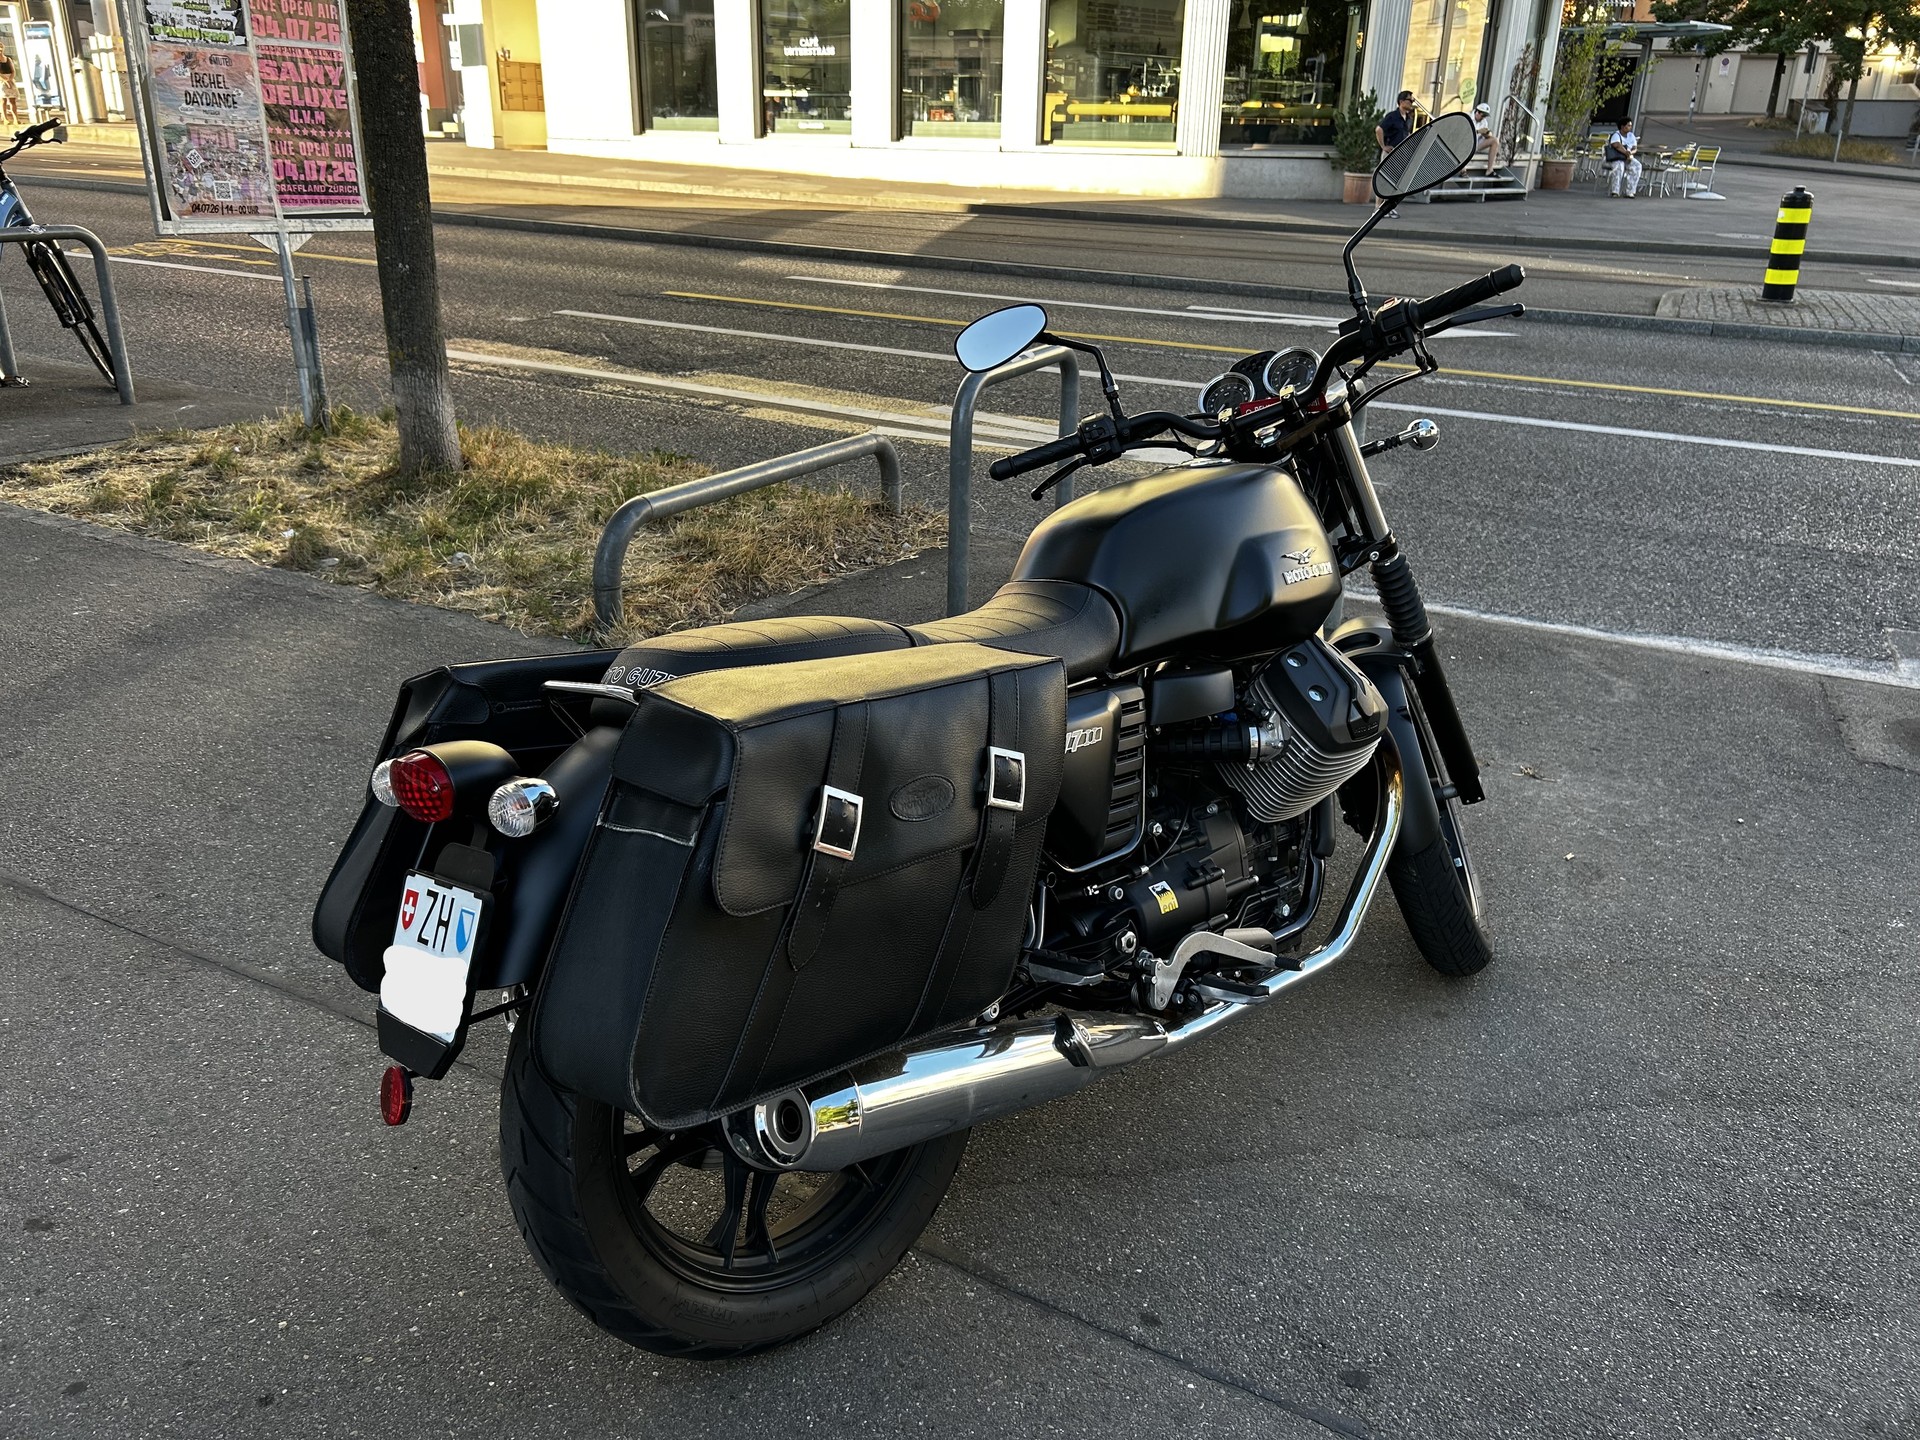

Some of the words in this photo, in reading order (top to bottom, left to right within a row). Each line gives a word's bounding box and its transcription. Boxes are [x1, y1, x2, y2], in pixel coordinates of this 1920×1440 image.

[281, 0, 313, 17] OPEN
[318, 3, 338, 20] AIR
[251, 13, 341, 45] 04.07.26
[190, 72, 230, 90] IRCHEL
[257, 58, 343, 86] SAMY
[184, 90, 238, 109] DAYDANCE
[262, 83, 348, 110] DELUXE
[299, 141, 330, 157] OPEN
[334, 143, 354, 158] AIR
[272, 158, 357, 182] 04.07.26
[328, 183, 359, 194] ZÜRICH
[626, 667, 678, 687] GUZ
[417, 889, 455, 953] ZH
